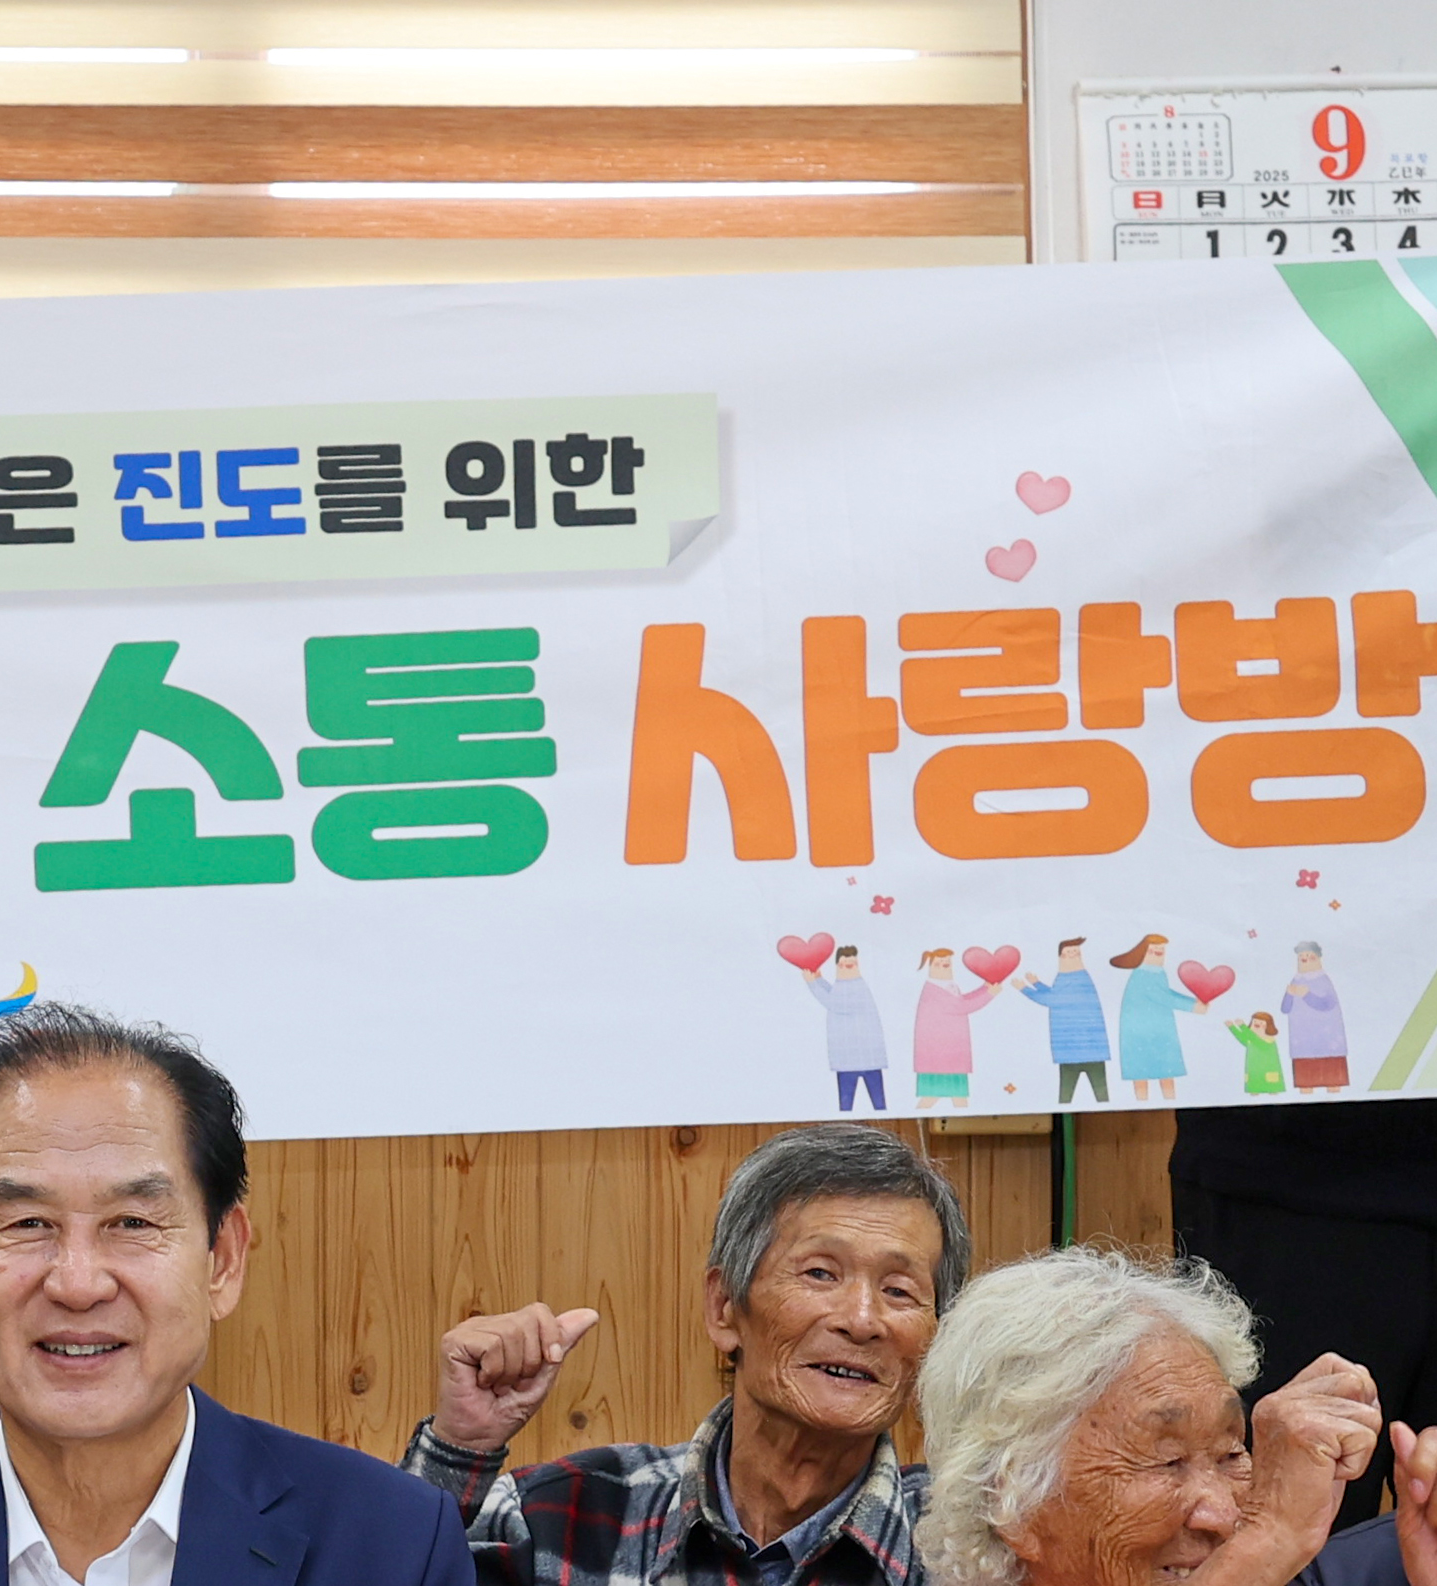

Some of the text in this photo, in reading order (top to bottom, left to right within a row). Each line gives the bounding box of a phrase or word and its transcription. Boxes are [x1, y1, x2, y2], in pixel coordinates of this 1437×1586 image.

[1164, 105, 1175, 118] 8
[1312, 104, 1366, 181] 9
[1253, 169, 1290, 183] 2025
[1133, 190, 1163, 209] 日
[1196, 190, 1226, 209] 月
[1260, 190, 1290, 209] 火
[1327, 188, 1356, 206] 水
[1392, 187, 1422, 205] 木
[1206, 230, 1220, 258] 1
[1266, 229, 1288, 256] 2
[1332, 227, 1355, 252] 3
[1397, 225, 1420, 249] 4
[113, 443, 407, 542] 진도를
[443, 432, 646, 532] 위한
[33, 626, 558, 893] 소통
